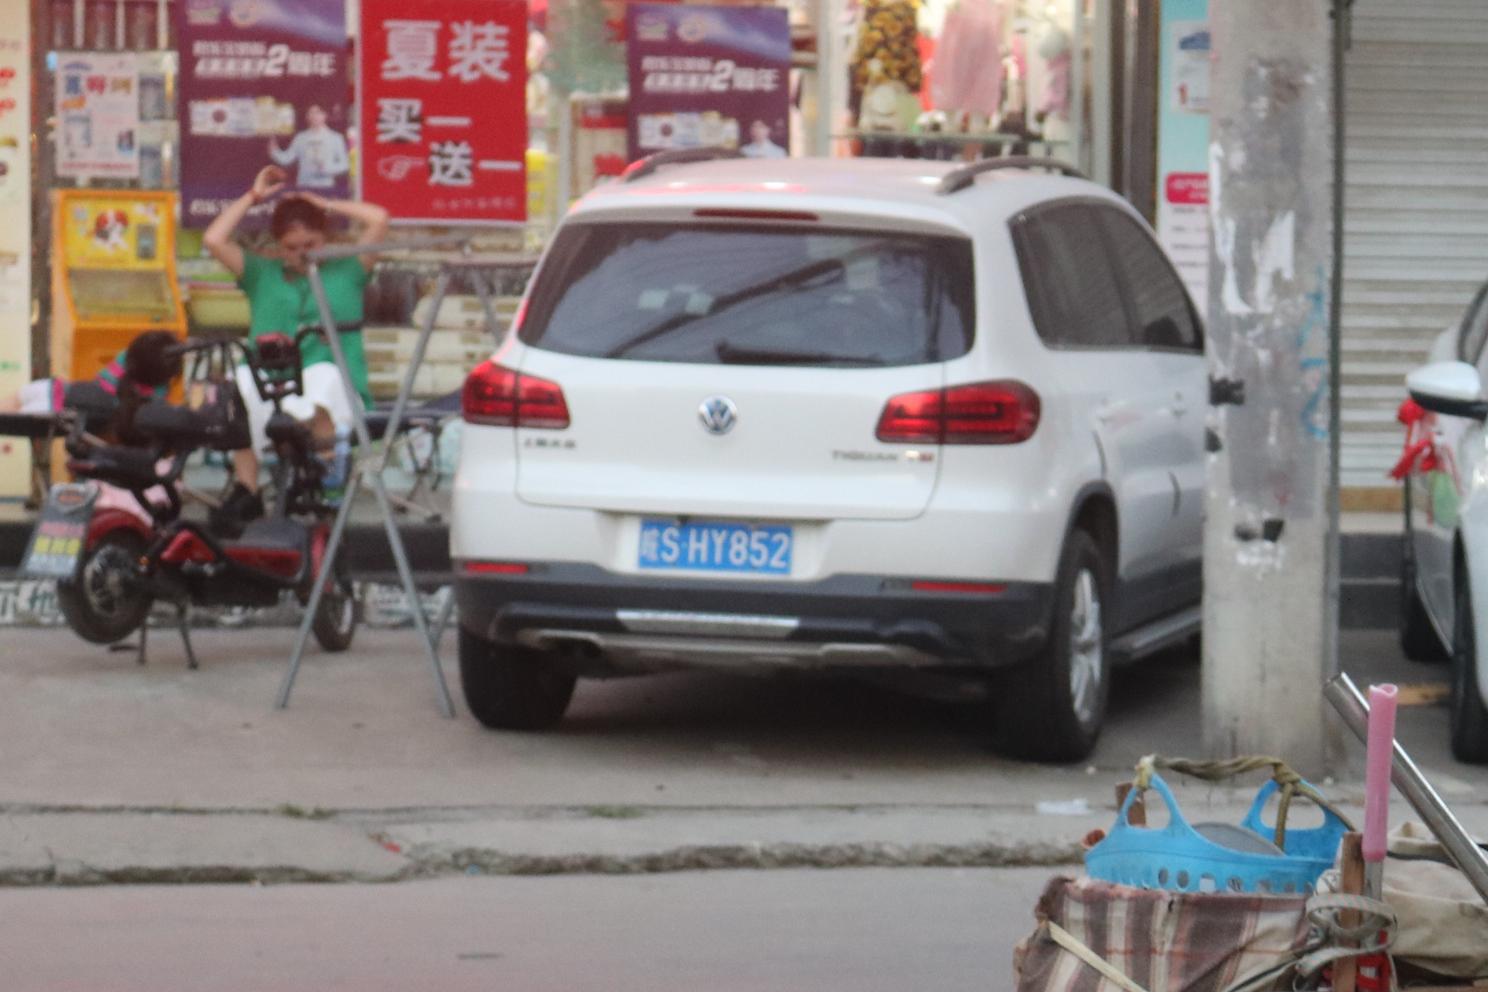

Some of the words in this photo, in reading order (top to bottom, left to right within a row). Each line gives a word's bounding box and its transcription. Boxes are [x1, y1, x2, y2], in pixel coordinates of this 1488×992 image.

[381, 19, 510, 82] 夏装
[376, 98, 472, 143] 买一
[428, 141, 523, 186] 送一
